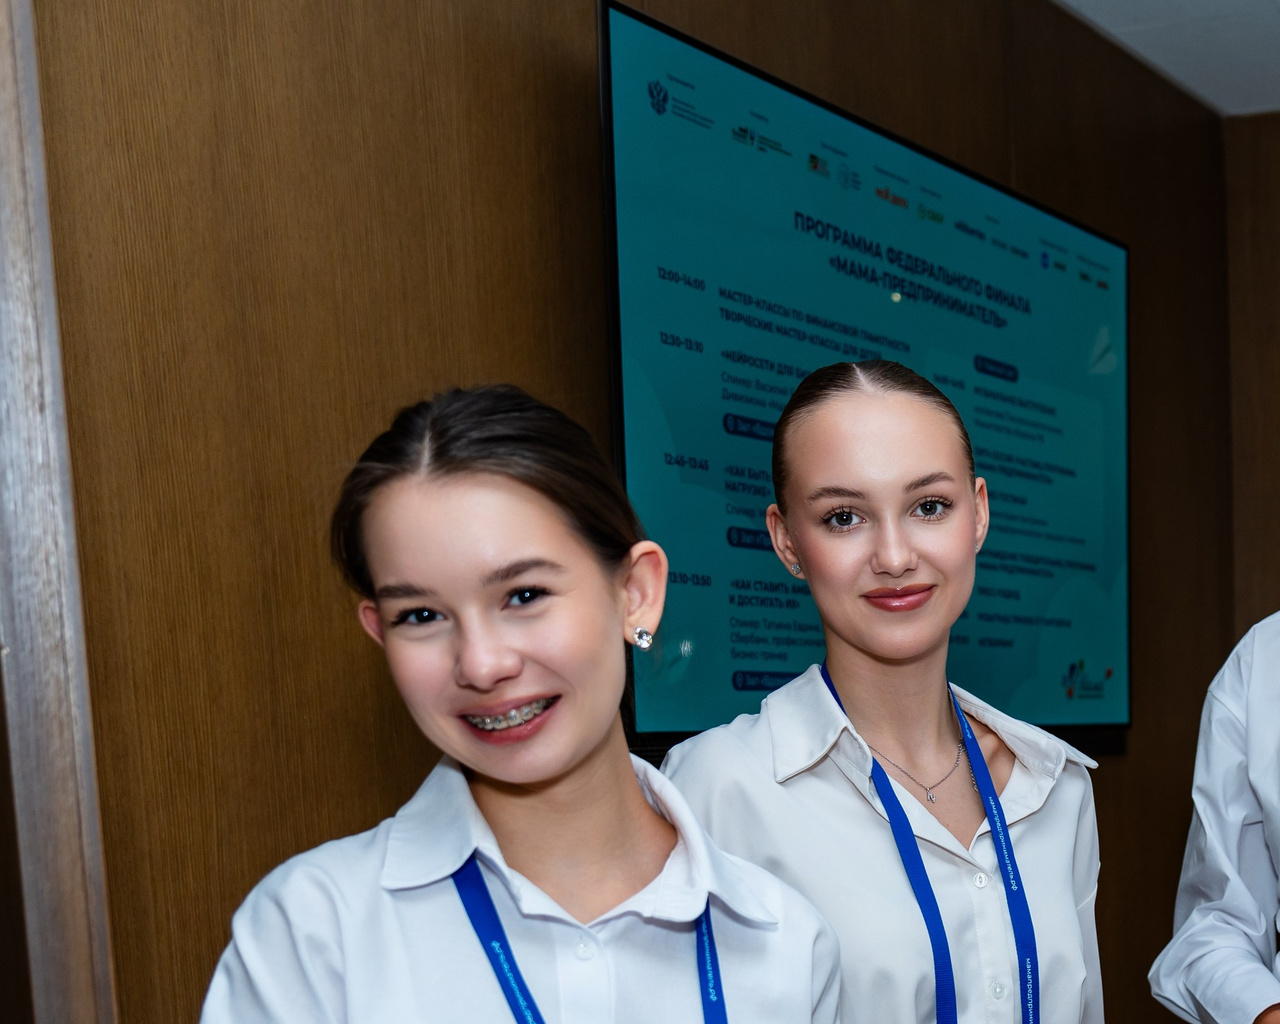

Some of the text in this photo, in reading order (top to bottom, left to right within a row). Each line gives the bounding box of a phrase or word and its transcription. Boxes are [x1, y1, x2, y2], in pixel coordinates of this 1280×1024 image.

[794, 210, 883, 261] ПРОГРАММА
[886, 246, 983, 297] ФЕДЕРАЛЬНОГО
[984, 284, 1032, 315] ФИНАЛА
[657, 265, 706, 291] 12:00-14:00
[719, 287, 791, 320] МАСТЕР-КЛАССЫ
[719, 306, 774, 332] ТВОРЧЕСКИЕ
[775, 323, 842, 351] МАСТЕР-КЛАССЫ
[753, 580, 790, 594] СТАВИТЬ
[738, 595, 785, 610] ДОСТИГАТЬ
